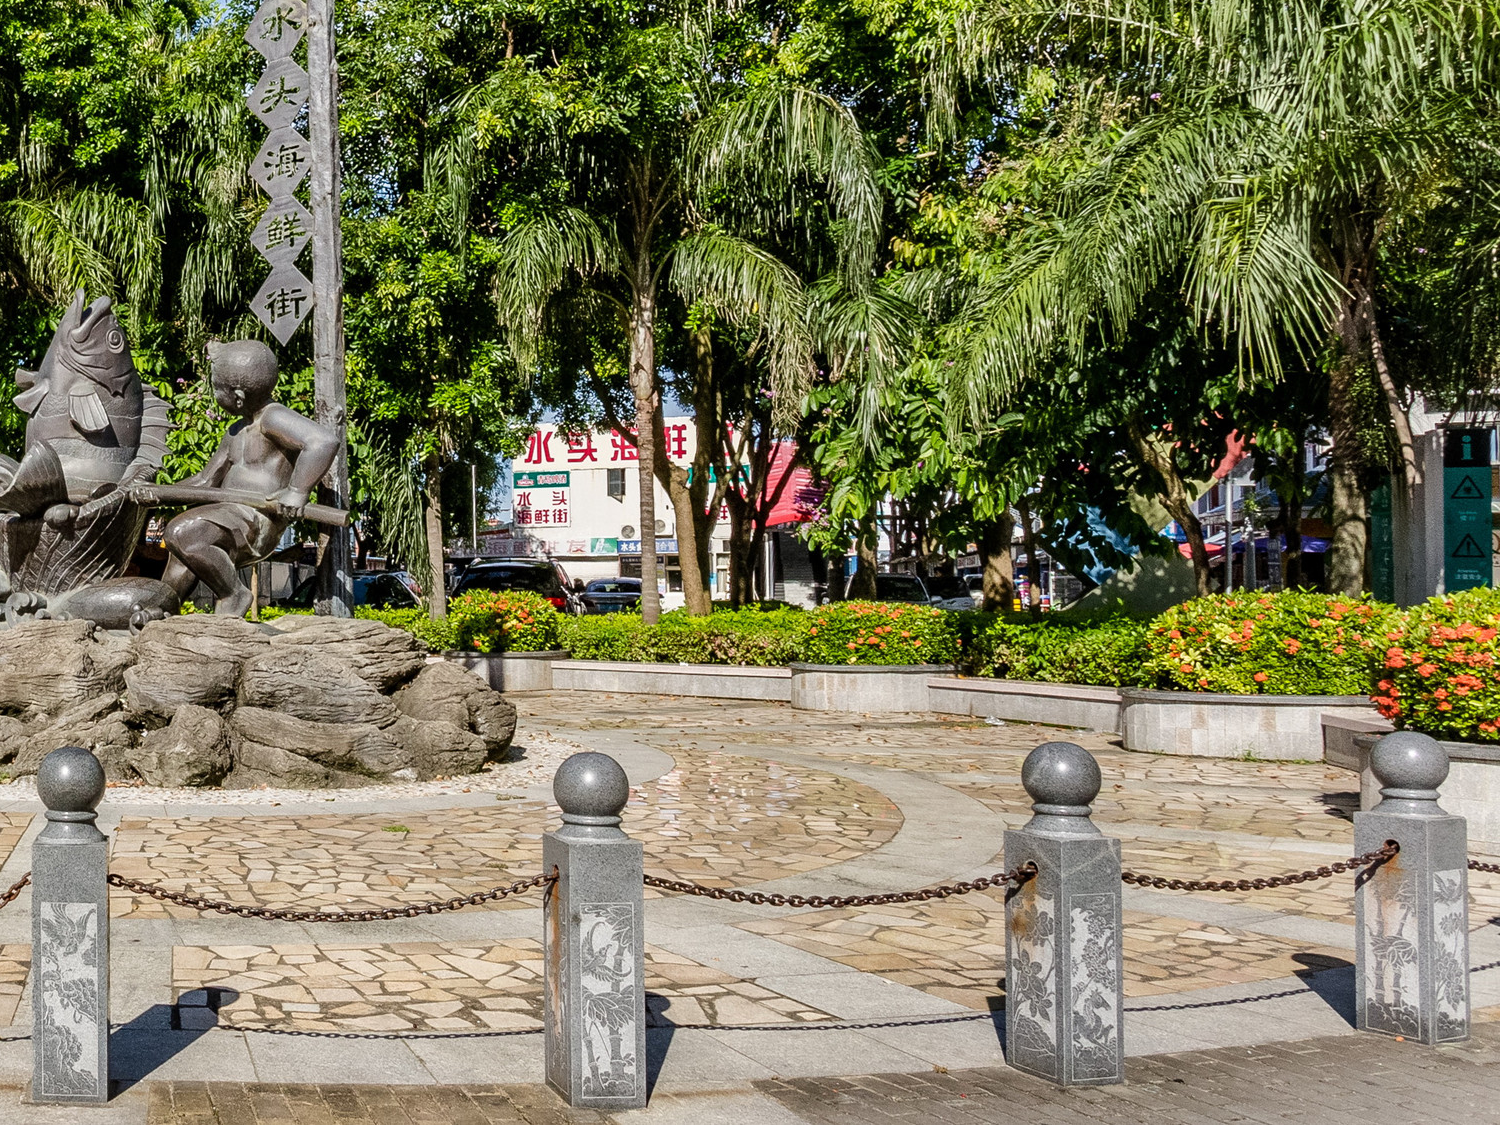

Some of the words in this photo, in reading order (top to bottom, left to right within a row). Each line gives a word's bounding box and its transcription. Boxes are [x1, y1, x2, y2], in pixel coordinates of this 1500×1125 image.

[260, 6, 306, 325] 水头海鲜街
[524, 420, 733, 465] 水头海鲜
[517, 491, 567, 507] 水头
[517, 509, 568, 524] 海鲜街
